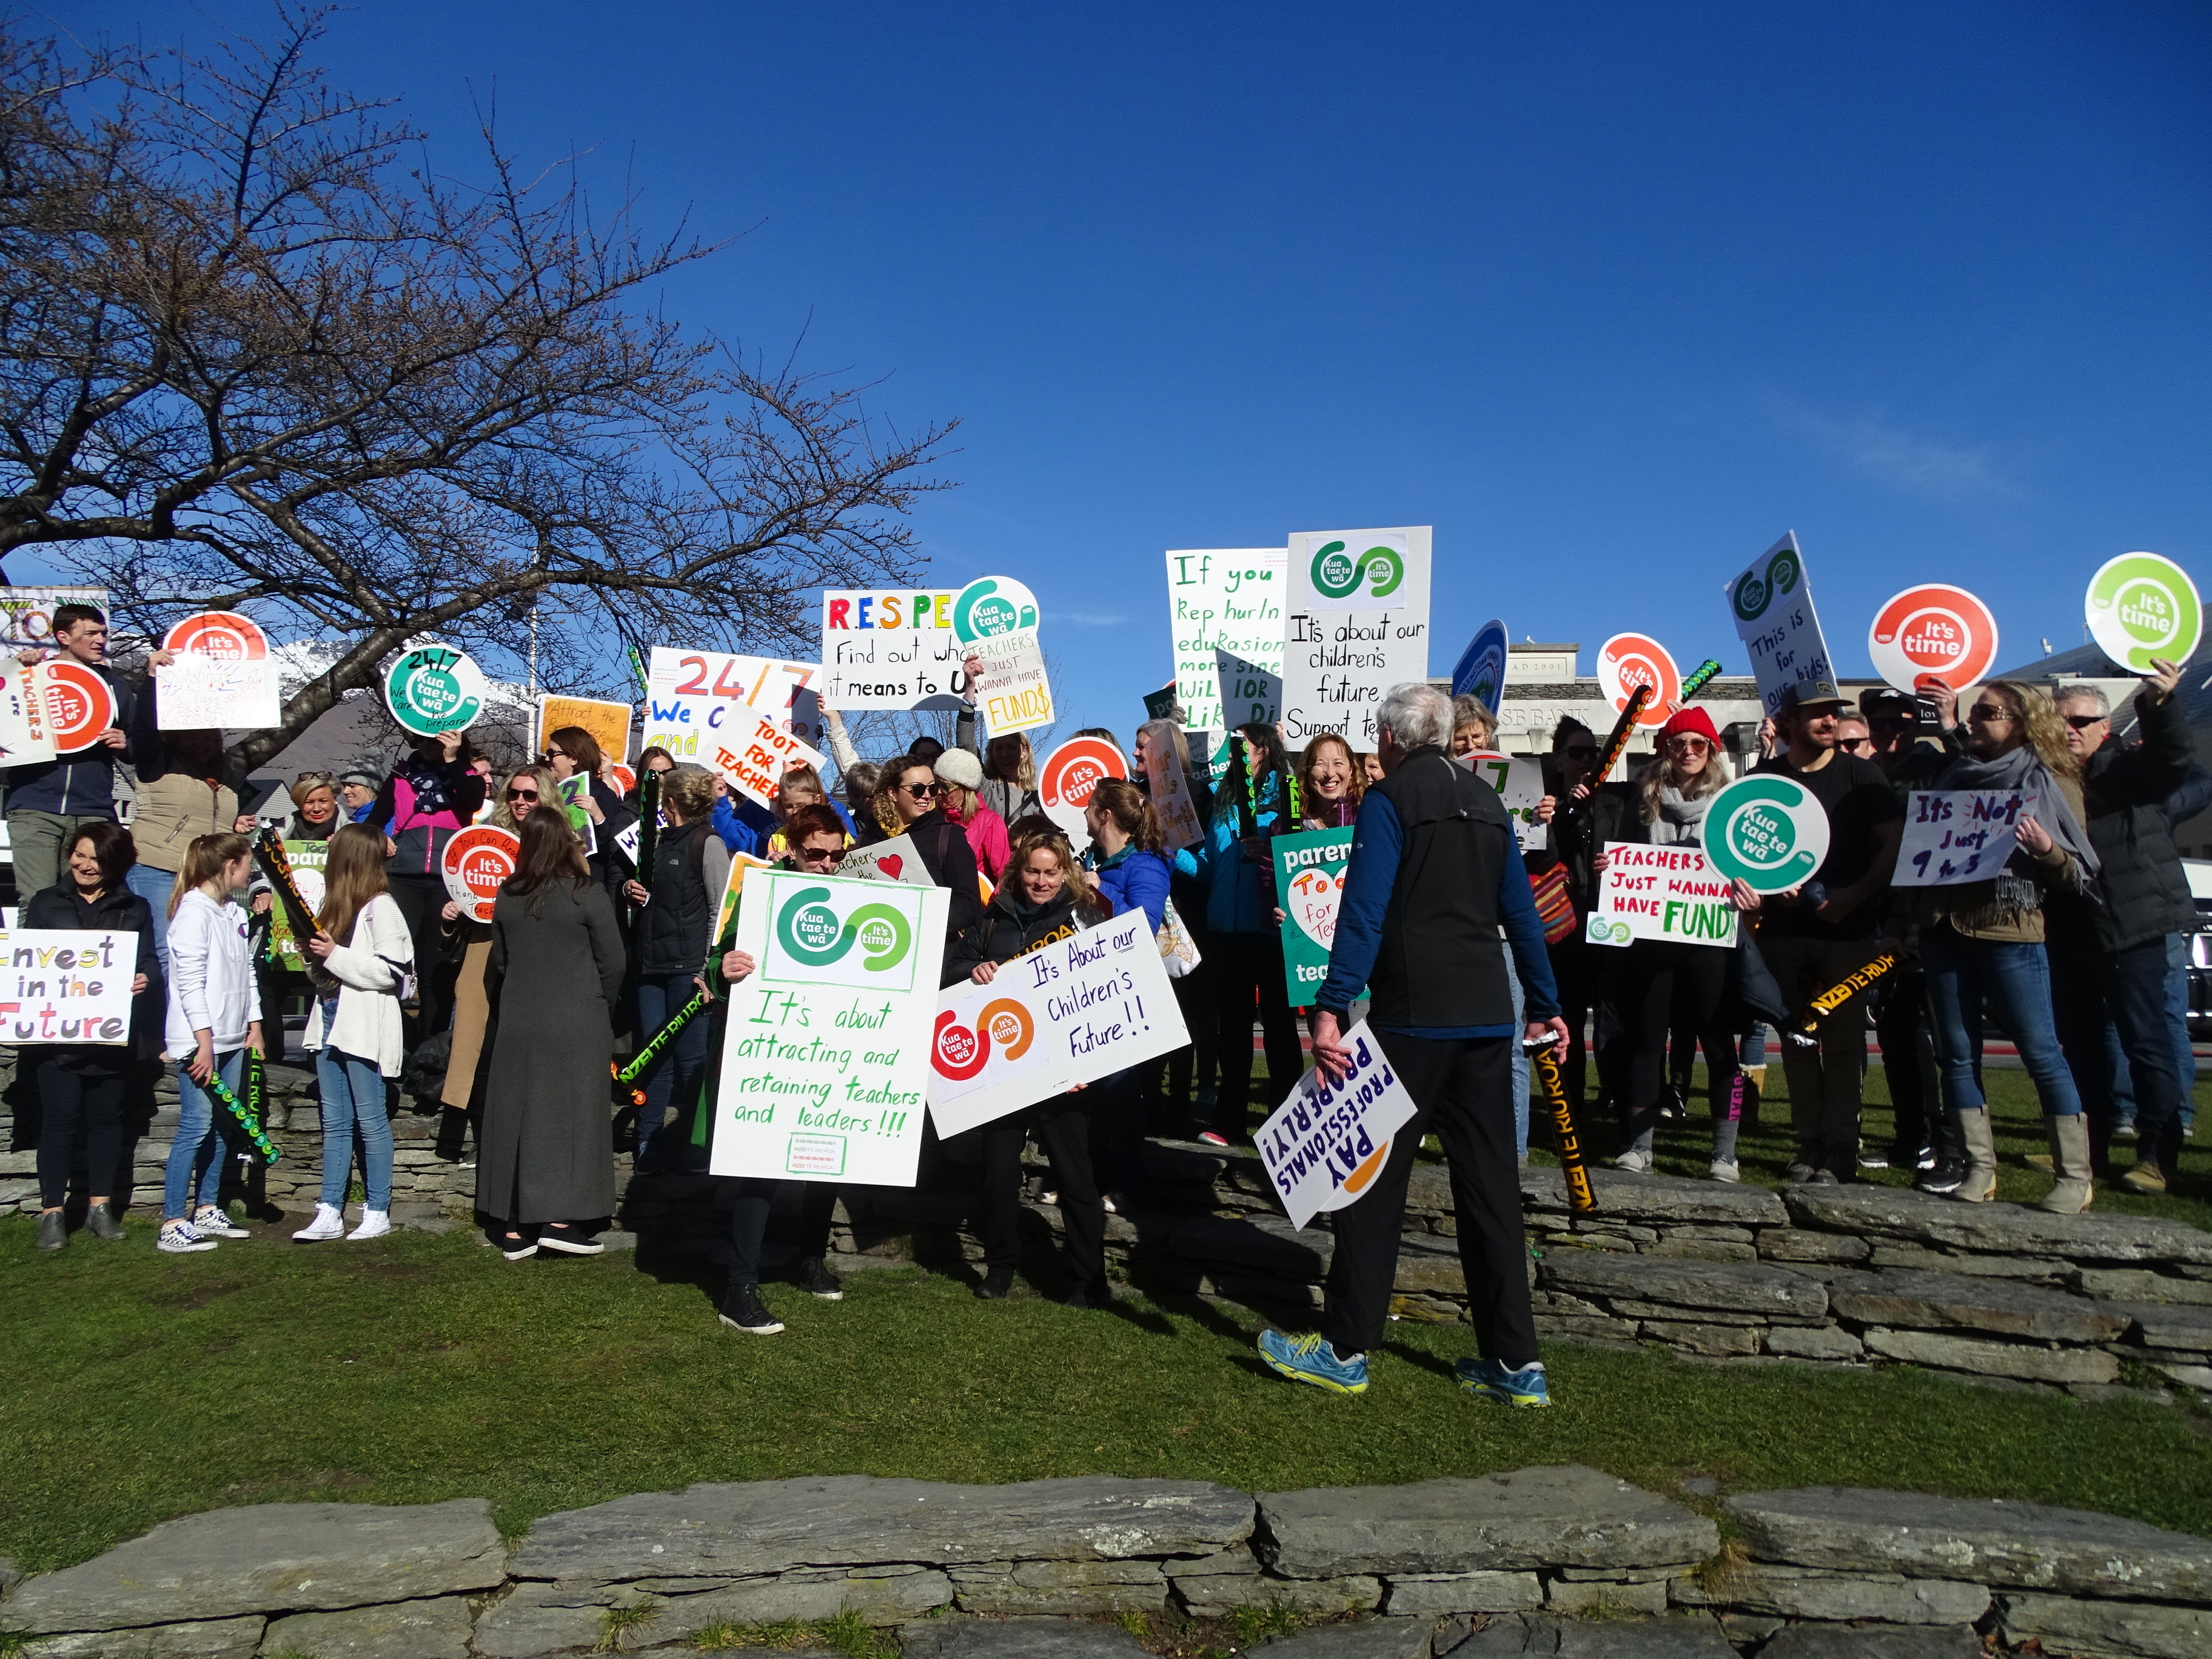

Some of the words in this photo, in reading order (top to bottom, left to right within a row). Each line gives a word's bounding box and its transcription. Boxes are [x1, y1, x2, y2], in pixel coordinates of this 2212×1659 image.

[1174, 555, 1213, 586] If
[1225, 569, 1273, 594] you
[1326, 559, 1342, 568] Kua
[1369, 569, 1390, 578] time
[974, 605, 999, 619] Kua
[2140, 592, 2166, 615] It's
[978, 616, 1000, 628] tae
[1001, 612, 1014, 622] te
[1290, 615, 1324, 643] It's
[1335, 613, 1392, 642] about
[1396, 624, 1425, 639] our
[1925, 621, 1955, 640] It's
[2120, 604, 2170, 634] time
[209, 637, 233, 648] It's
[1751, 626, 1786, 657] This
[1790, 609, 1803, 631] is
[1905, 633, 1960, 656] time
[837, 638, 874, 665] Find
[888, 635, 920, 663] out
[969, 633, 1034, 660] TEACHERS
[1310, 643, 1386, 668] children's
[408, 648, 463, 674] 24/7
[992, 655, 1021, 672] JUST
[1180, 662, 1227, 673] more
[1775, 649, 1795, 672] for
[417, 672, 445, 689] Kua
[830, 671, 842, 697] it
[849, 683, 908, 697] means
[916, 671, 937, 695] to
[978, 675, 1013, 692] WANNA
[1017, 668, 1042, 684] HAVE
[1316, 674, 1384, 703] future.
[390, 686, 406, 699] We
[417, 683, 441, 698] tae
[442, 691, 457, 703] te
[10, 695, 21, 717] are
[45, 687, 65, 728] time
[61, 697, 78, 722] It's
[421, 698, 444, 711] wā
[432, 711, 447, 719] We
[548, 700, 593, 719] Attract
[602, 709, 616, 724] the
[652, 700, 691, 723] We
[1286, 708, 1350, 739] Support
[646, 729, 699, 756] and
[754, 719, 800, 756] TOOT
[744, 743, 776, 773] FOR
[1071, 767, 1094, 785] It's
[1743, 806, 1778, 834] Kua
[1916, 795, 1953, 823] Its
[1972, 794, 2023, 825] Not
[457, 837, 475, 851] You
[480, 832, 497, 845] Can
[1740, 820, 1769, 843] tae
[1769, 835, 1788, 854] te
[1939, 829, 1989, 850] Just
[1607, 845, 1704, 871] TEACHERS
[1742, 839, 1769, 861] wā
[480, 858, 503, 874] It's
[1912, 850, 1932, 878] 9
[449, 885, 478, 901] Thank
[1610, 872, 1657, 890] JUST
[1669, 879, 1732, 899] WANNA
[799, 911, 824, 923] Kua
[1304, 902, 1332, 924] for
[1614, 896, 1660, 916] HAVE
[801, 922, 822, 933] tae
[823, 923, 836, 934] te
[808, 933, 826, 944] wā
[862, 933, 891, 946] time
[873, 925, 888, 936] It's
[1027, 954, 1059, 989] It's
[1067, 932, 1107, 972] About
[1113, 927, 1137, 950] our
[18, 974, 46, 998] in
[58, 974, 104, 999] the
[1048, 968, 1133, 1022] Children's
[748, 990, 813, 1028] It's
[835, 997, 893, 1030] about
[993, 1025, 1019, 1041] time
[998, 1018, 1013, 1029] It's
[941, 1033, 961, 1047] Kua
[945, 1042, 964, 1054] tae
[962, 1037, 973, 1047] te
[618, 1047, 654, 1084] NZEI
[649, 1030, 669, 1050] TE
[737, 1033, 852, 1074] attracting
[863, 1048, 900, 1067] and
[954, 1048, 970, 1061] wā
[740, 1071, 833, 1108] retaining
[844, 1075, 921, 1105] teachers
[734, 1103, 776, 1124] and
[1276, 1063, 1395, 1196] PROFESSIONALS
[1325, 1123, 1375, 1191] PAY
